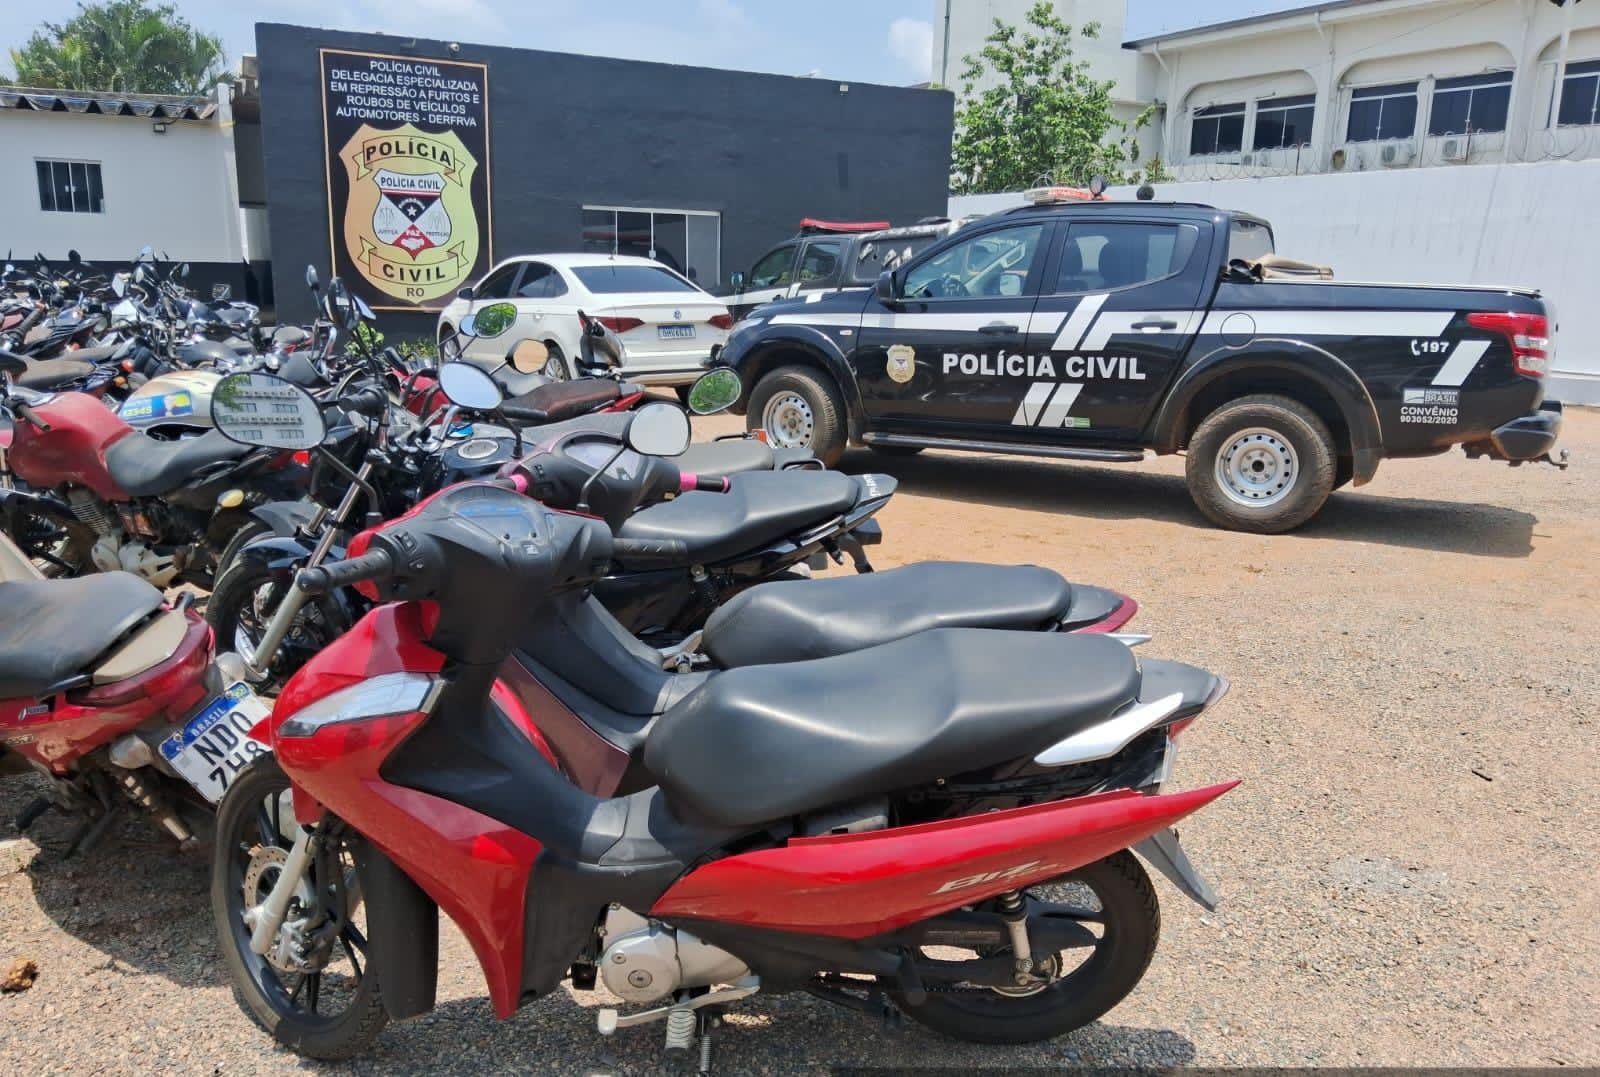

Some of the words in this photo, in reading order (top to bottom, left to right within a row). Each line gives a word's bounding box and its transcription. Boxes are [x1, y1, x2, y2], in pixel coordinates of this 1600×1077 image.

[370, 60, 413, 74] POLÍCIA
[415, 65, 441, 77] CIVIL
[331, 69, 394, 84] DELEGACIA
[396, 75, 478, 92] ESPECIALIZADA
[331, 81, 347, 92] EM
[350, 83, 417, 98] REPRESSÃO
[419, 90, 426, 99] A
[429, 90, 470, 103] FURTOS
[473, 94, 480, 104] E
[346, 95, 394, 108] ROUBOS
[397, 100, 411, 110] DE
[414, 99, 466, 114] VEÍCULOS
[336, 107, 420, 123] AUTOMOTORES
[429, 113, 477, 127] DERFRVA
[366, 137, 451, 166] POLÍCIA
[418, 180, 441, 190] CIVIL
[382, 263, 446, 282] CIVIL
[406, 287, 425, 297] RO
[1421, 341, 1449, 353] 197
[942, 350, 1056, 377] POLÍCIA
[1065, 355, 1146, 380] CIVIL
[1425, 394, 1458, 404] BRASIL
[1400, 405, 1458, 417] CONVÊNIO
[191, 707, 227, 737] BRASIL
